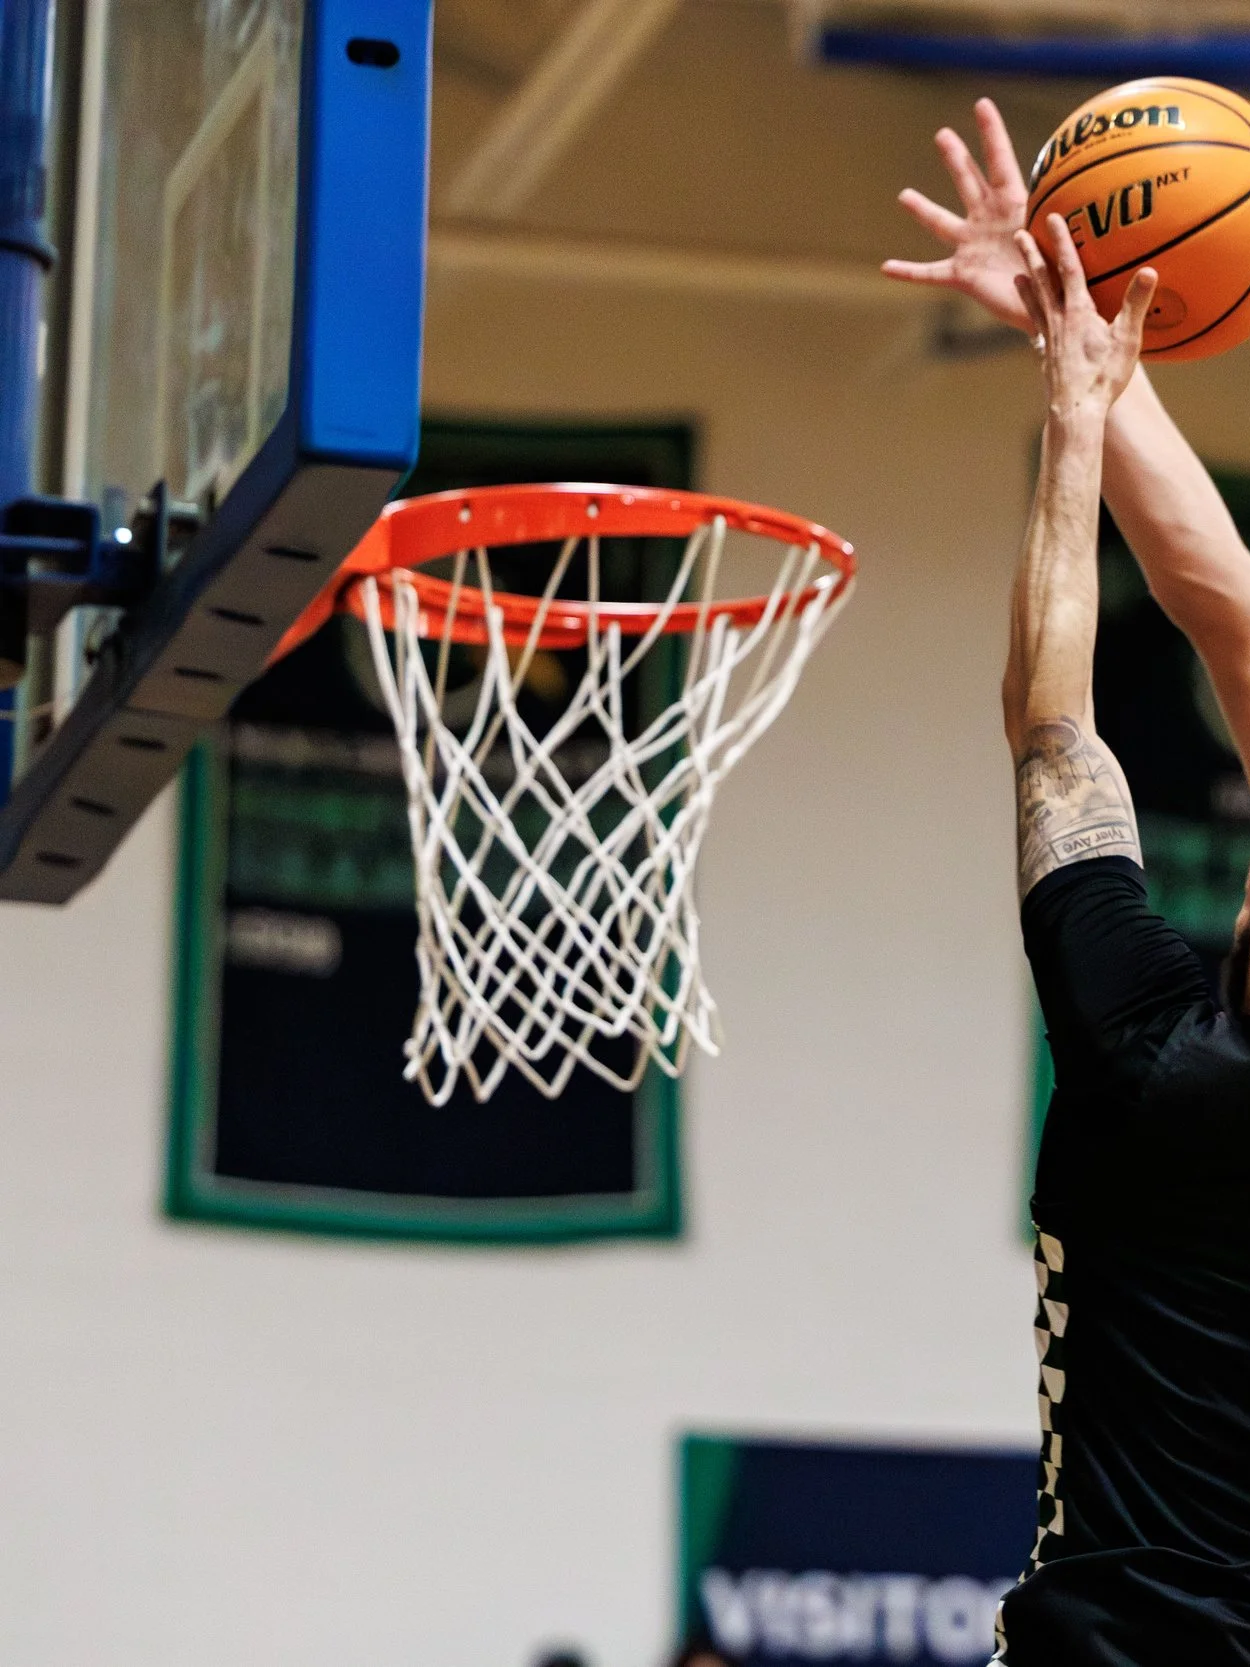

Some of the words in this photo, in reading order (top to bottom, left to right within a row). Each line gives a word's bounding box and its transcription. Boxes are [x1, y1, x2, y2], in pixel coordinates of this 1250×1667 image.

[1066, 179, 1153, 250] EVO
[1156, 166, 1191, 189] NXT
[1063, 836, 1091, 853] Ave
